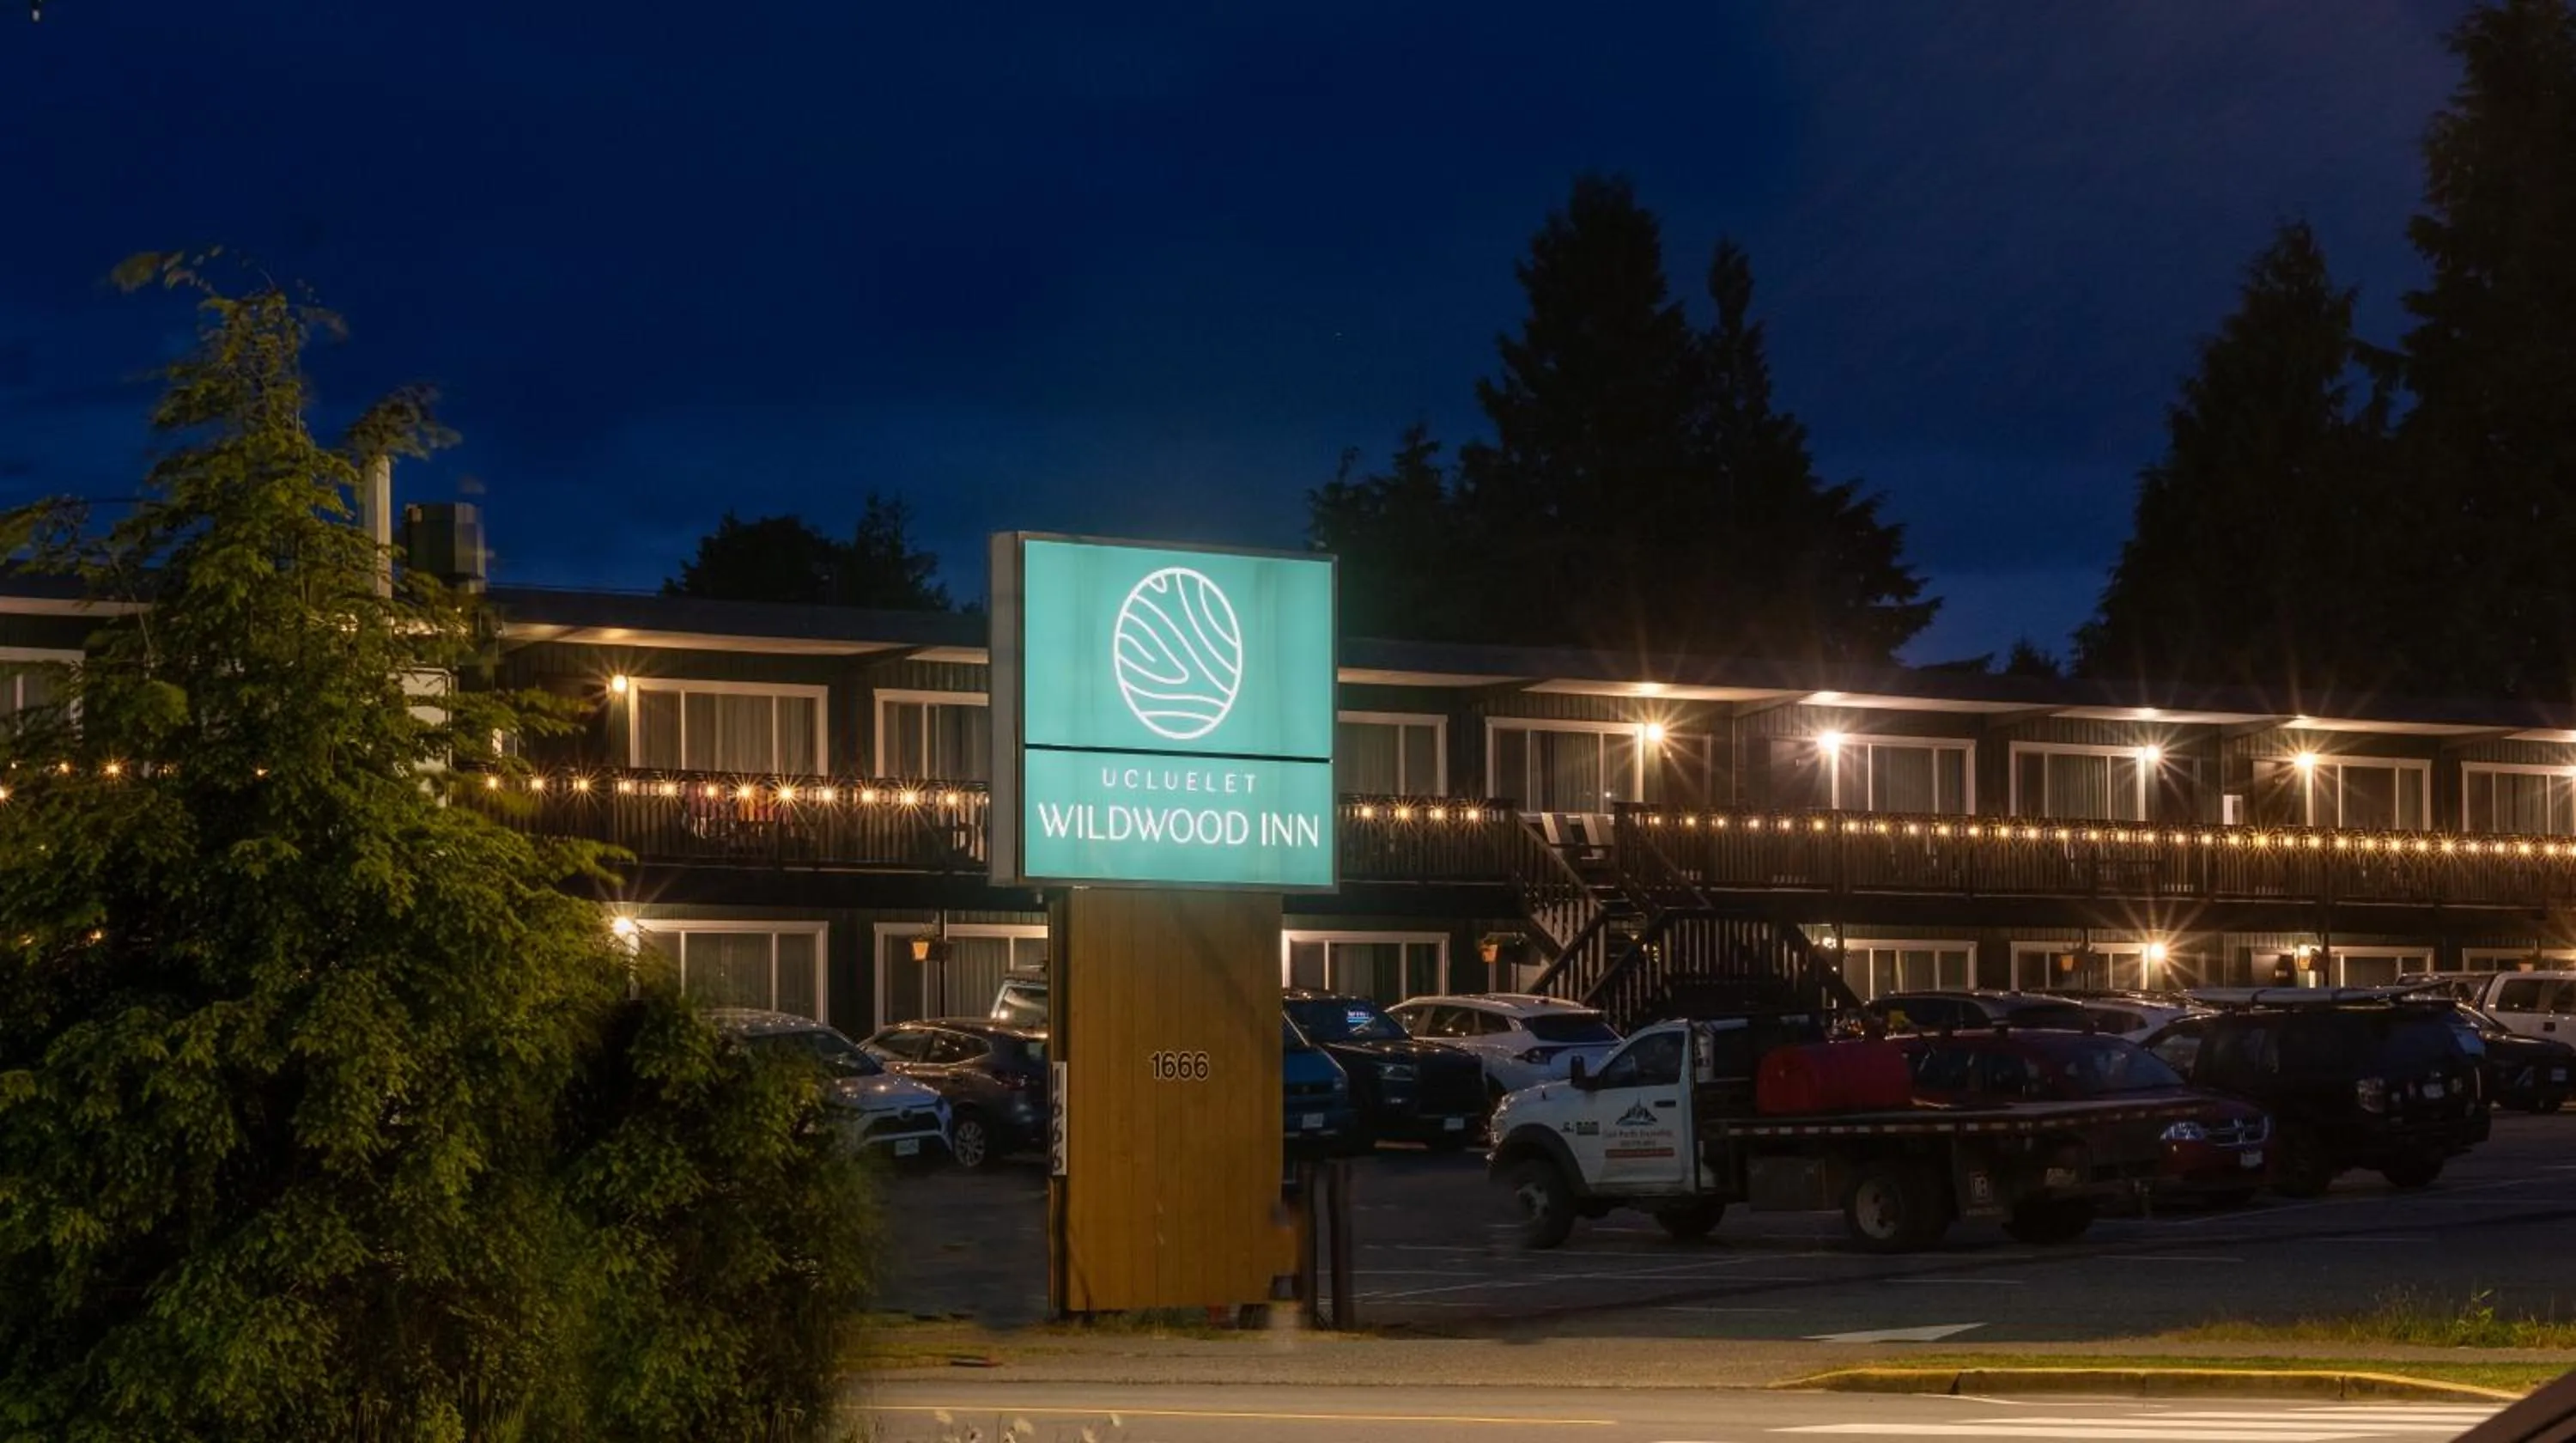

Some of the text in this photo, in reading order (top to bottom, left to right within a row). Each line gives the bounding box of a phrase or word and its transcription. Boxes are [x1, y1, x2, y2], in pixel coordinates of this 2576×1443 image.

[1103, 768, 1256, 793] UCLUELET
[1037, 802, 1319, 848] WILDWOOD INN
[1150, 1051, 1209, 1081] 1666
[1053, 1067, 1063, 1172] 1666
